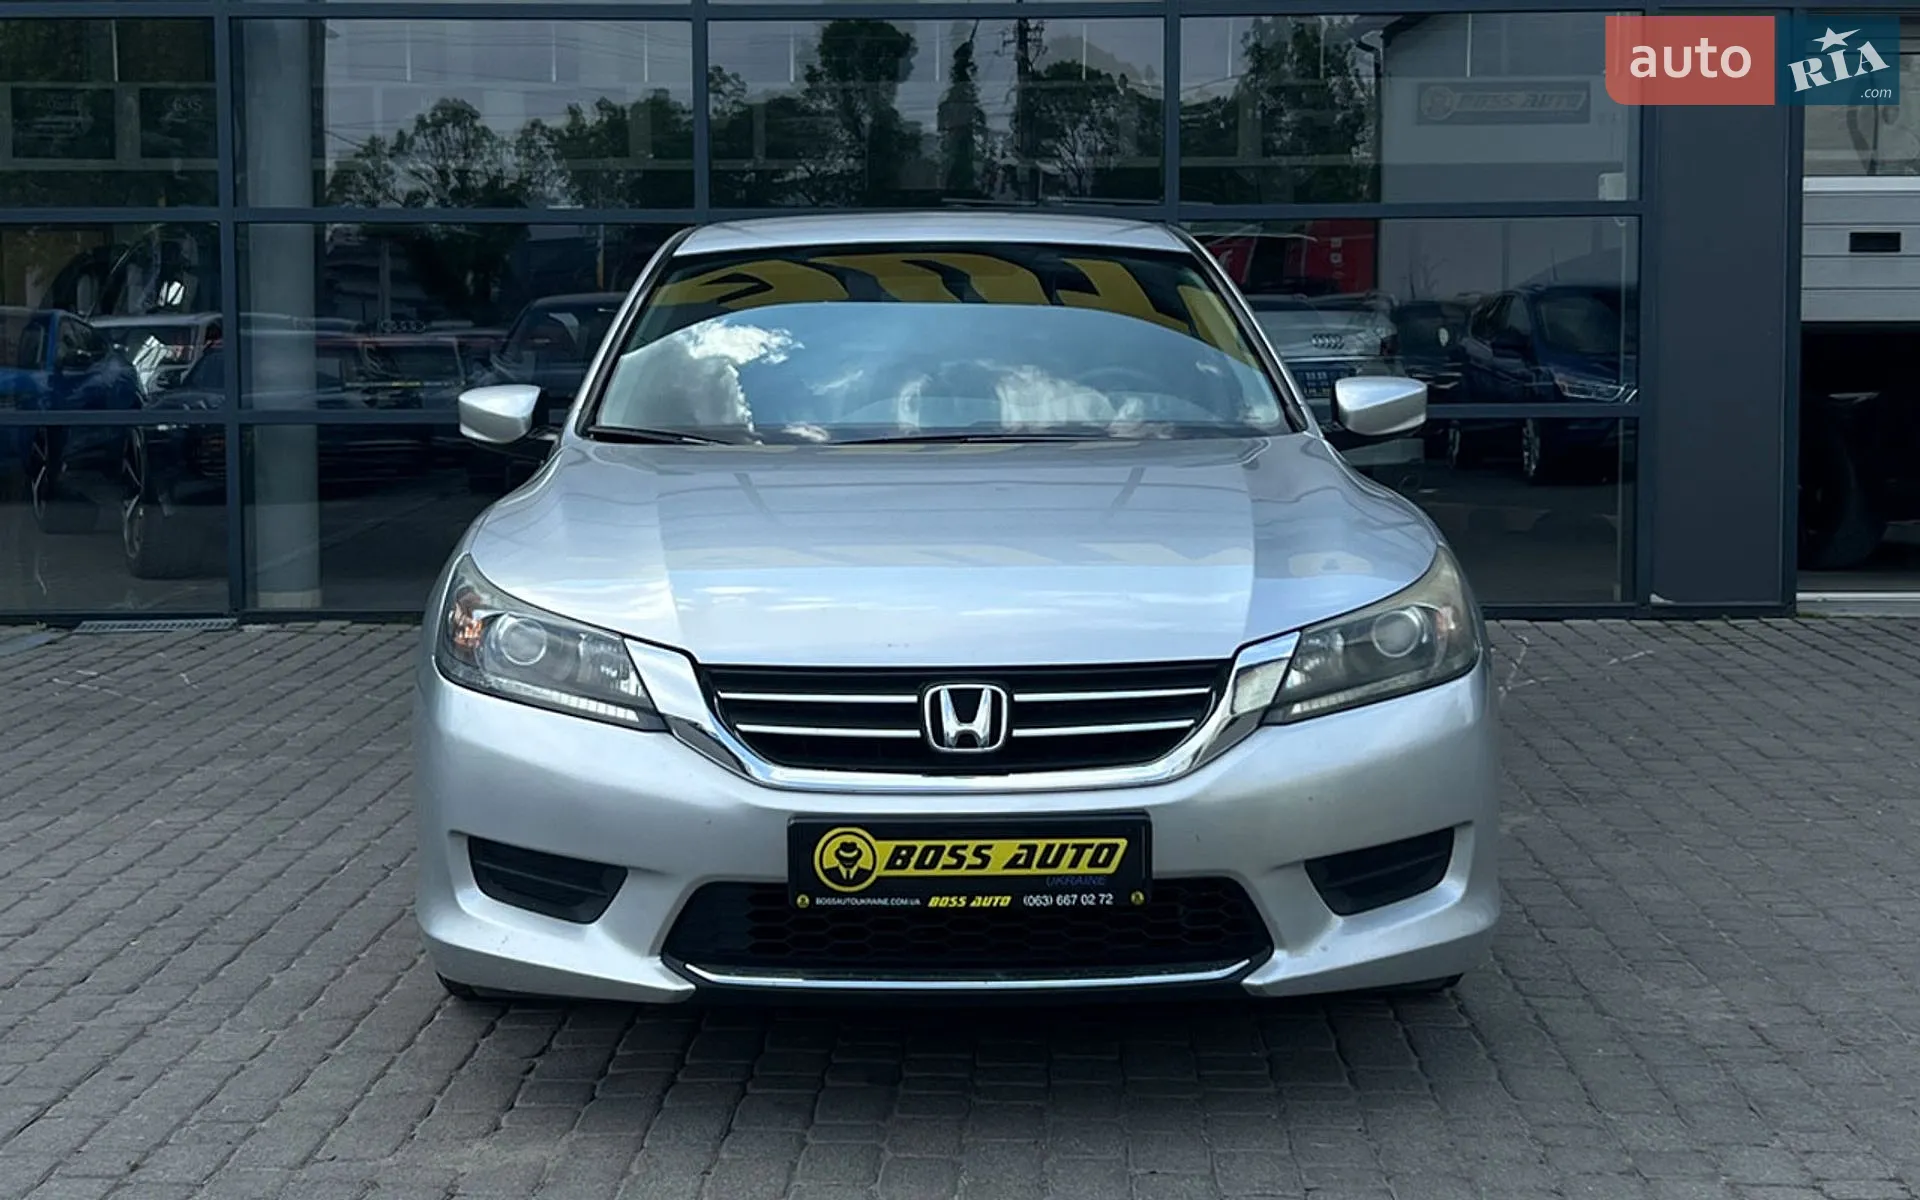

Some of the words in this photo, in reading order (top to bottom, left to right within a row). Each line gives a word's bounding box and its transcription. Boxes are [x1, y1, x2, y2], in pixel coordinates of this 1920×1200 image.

[883, 844, 994, 870] BOSS
[1001, 843, 1120, 870] AUTO
[928, 895, 968, 908] BOSS
[969, 895, 1012, 907] AUTO
[1023, 894, 1053, 907] (063)
[1056, 893, 1078, 906] 667
[1080, 893, 1097, 906] 02
[1098, 892, 1114, 905] 72
